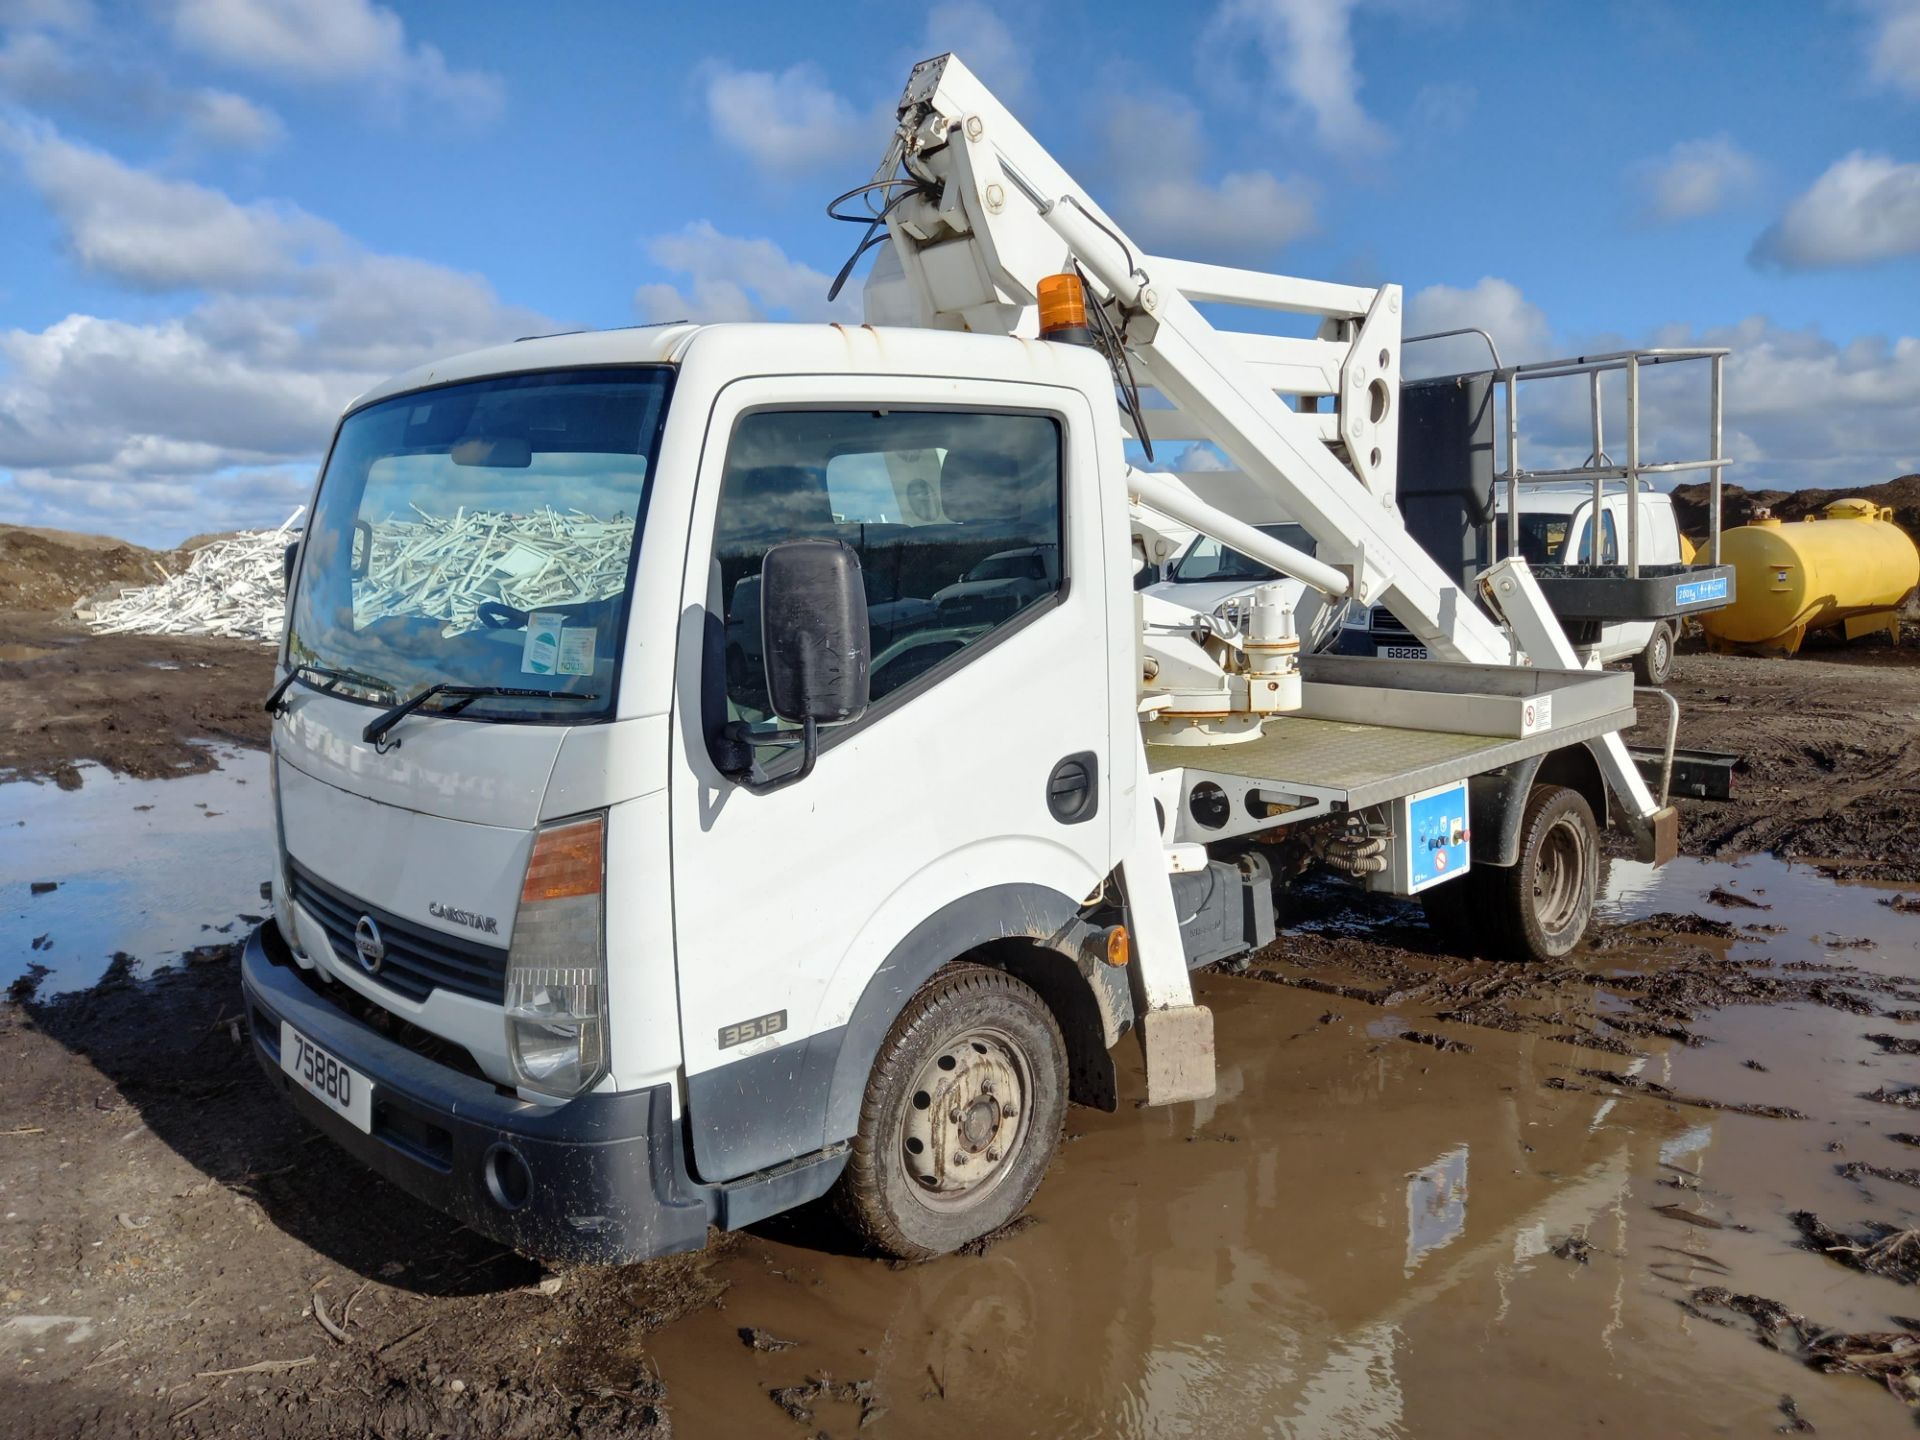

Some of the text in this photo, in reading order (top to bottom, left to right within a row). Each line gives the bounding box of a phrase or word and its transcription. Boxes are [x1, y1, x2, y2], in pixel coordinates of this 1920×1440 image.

[1387, 647, 1428, 660] 68285
[725, 1014, 782, 1046] 35.13
[294, 1033, 351, 1108] 75880
